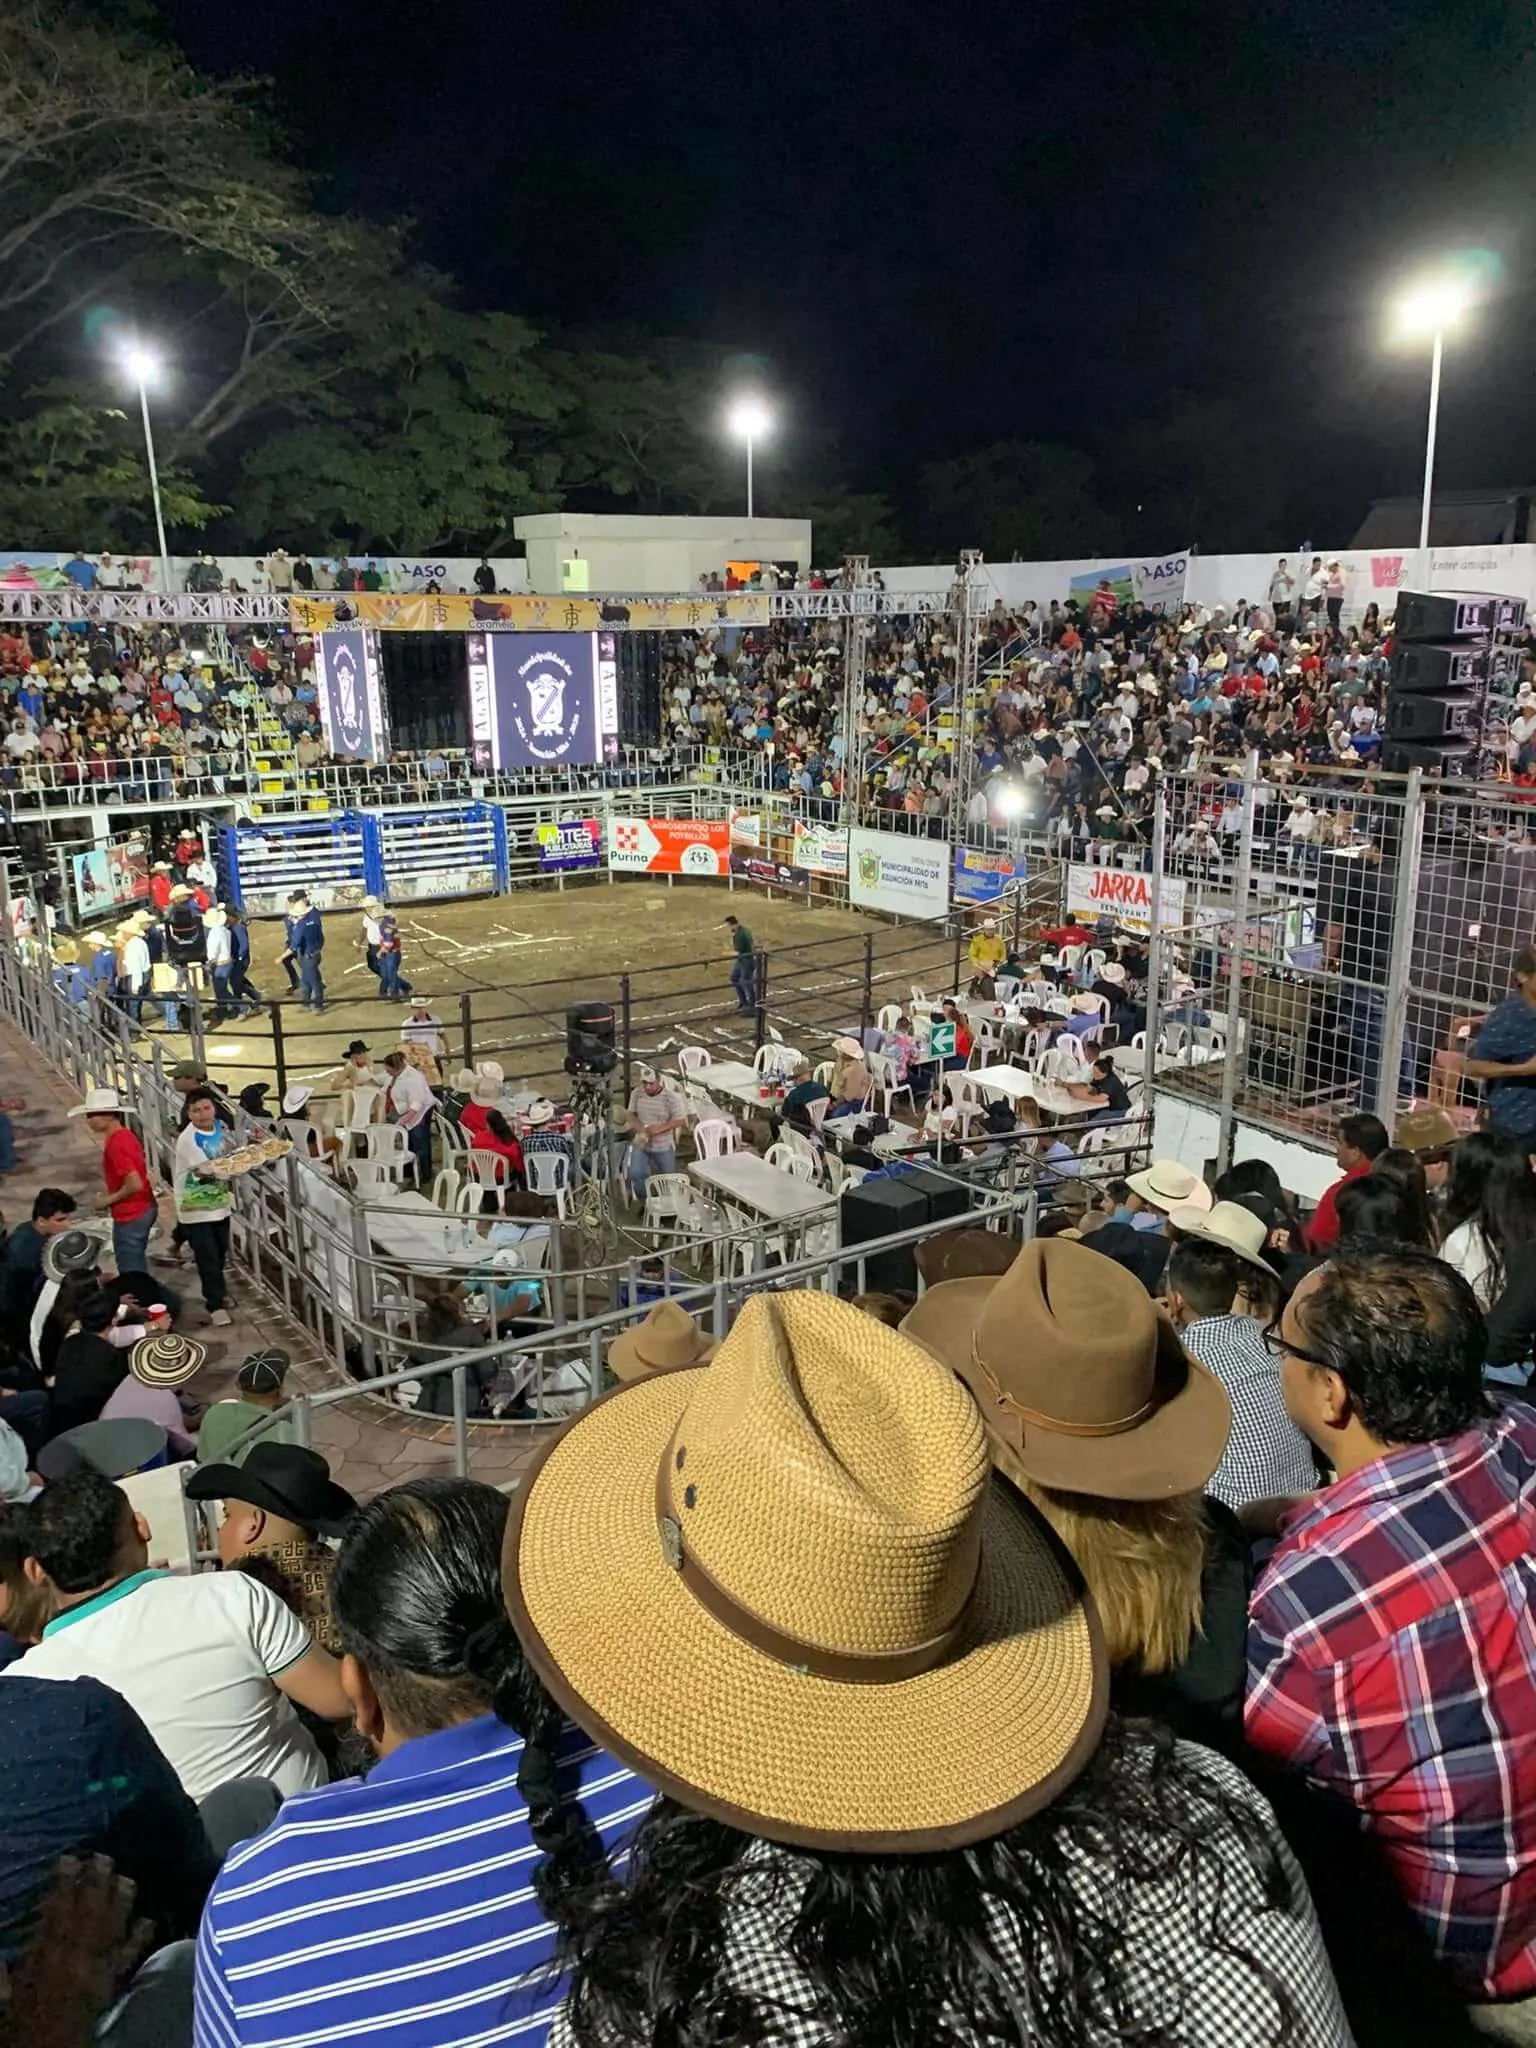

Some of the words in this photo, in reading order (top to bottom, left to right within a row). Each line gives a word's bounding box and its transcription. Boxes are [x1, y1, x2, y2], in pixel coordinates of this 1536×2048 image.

[468, 618, 516, 630] Caramelo
[610, 851, 649, 863] Purina
[881, 860, 930, 877] MUNICIPALIDAD
